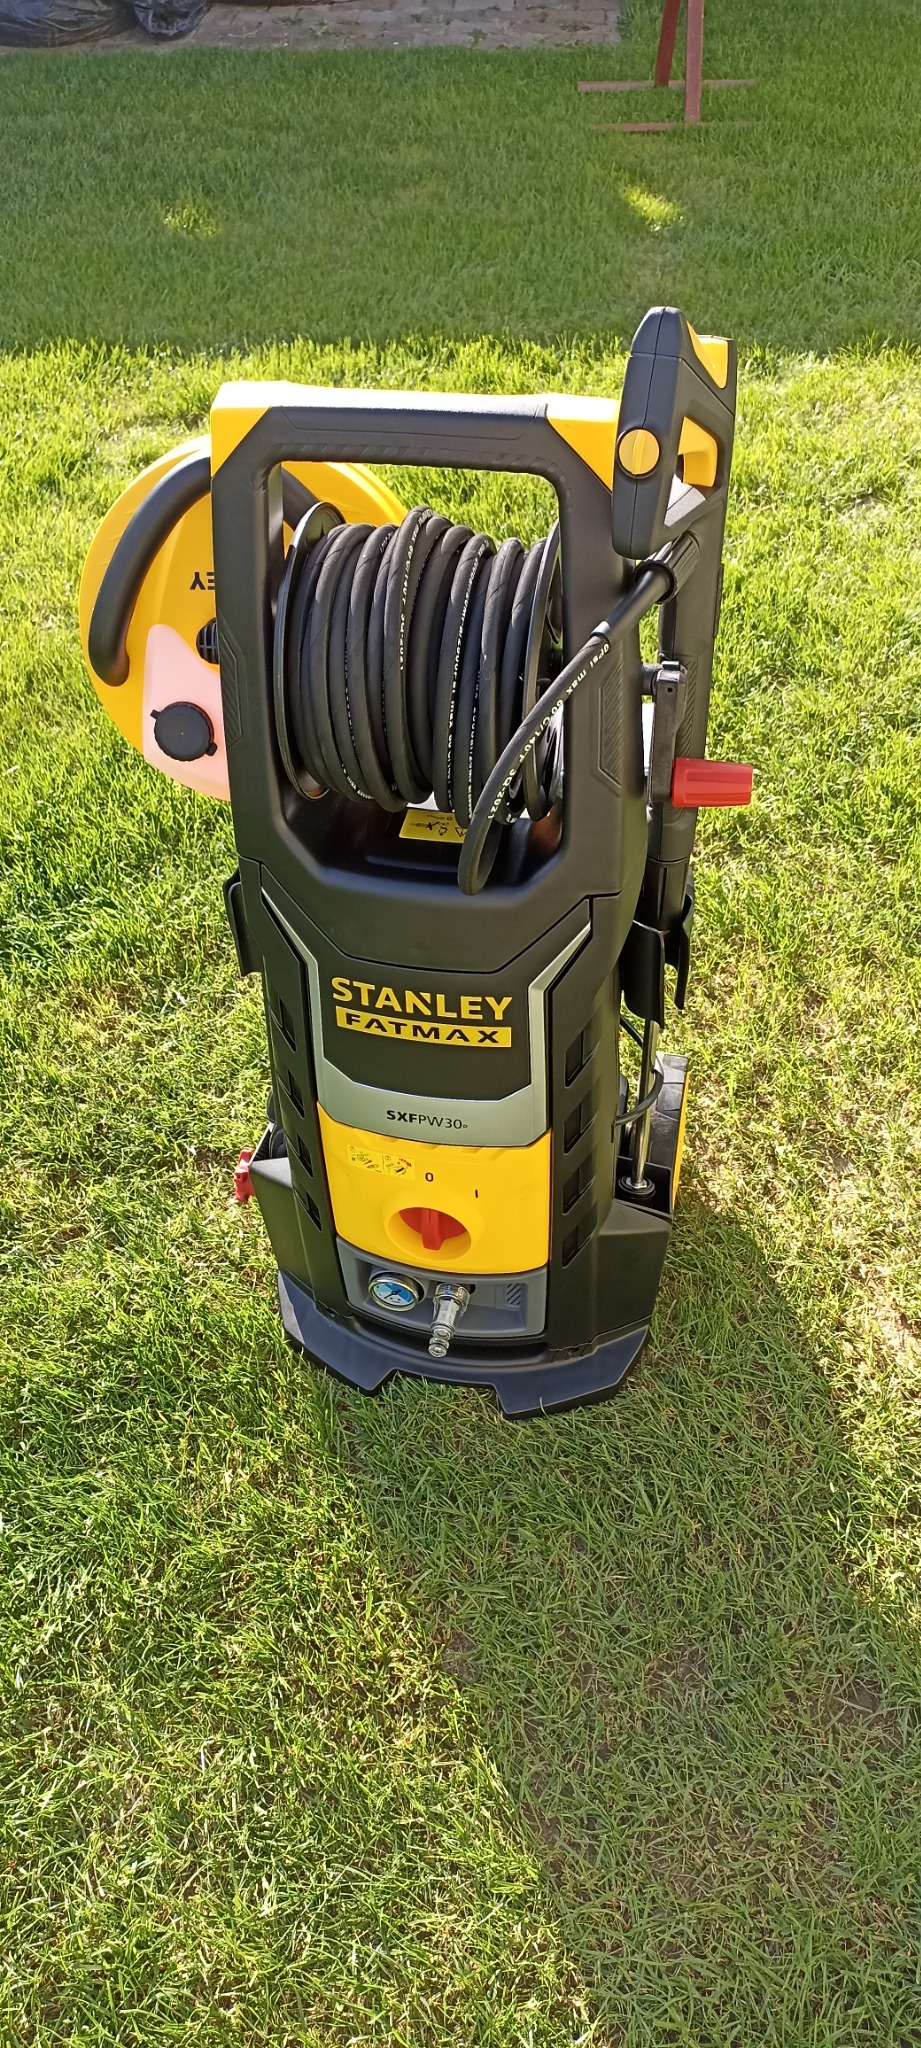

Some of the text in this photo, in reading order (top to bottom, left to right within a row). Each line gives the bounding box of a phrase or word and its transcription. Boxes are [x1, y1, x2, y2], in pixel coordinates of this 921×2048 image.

[566, 669, 587, 695] max
[488, 768, 517, 819] 3Q-2021
[331, 976, 513, 1021] STANLEY
[345, 1012, 499, 1044] FATMAX
